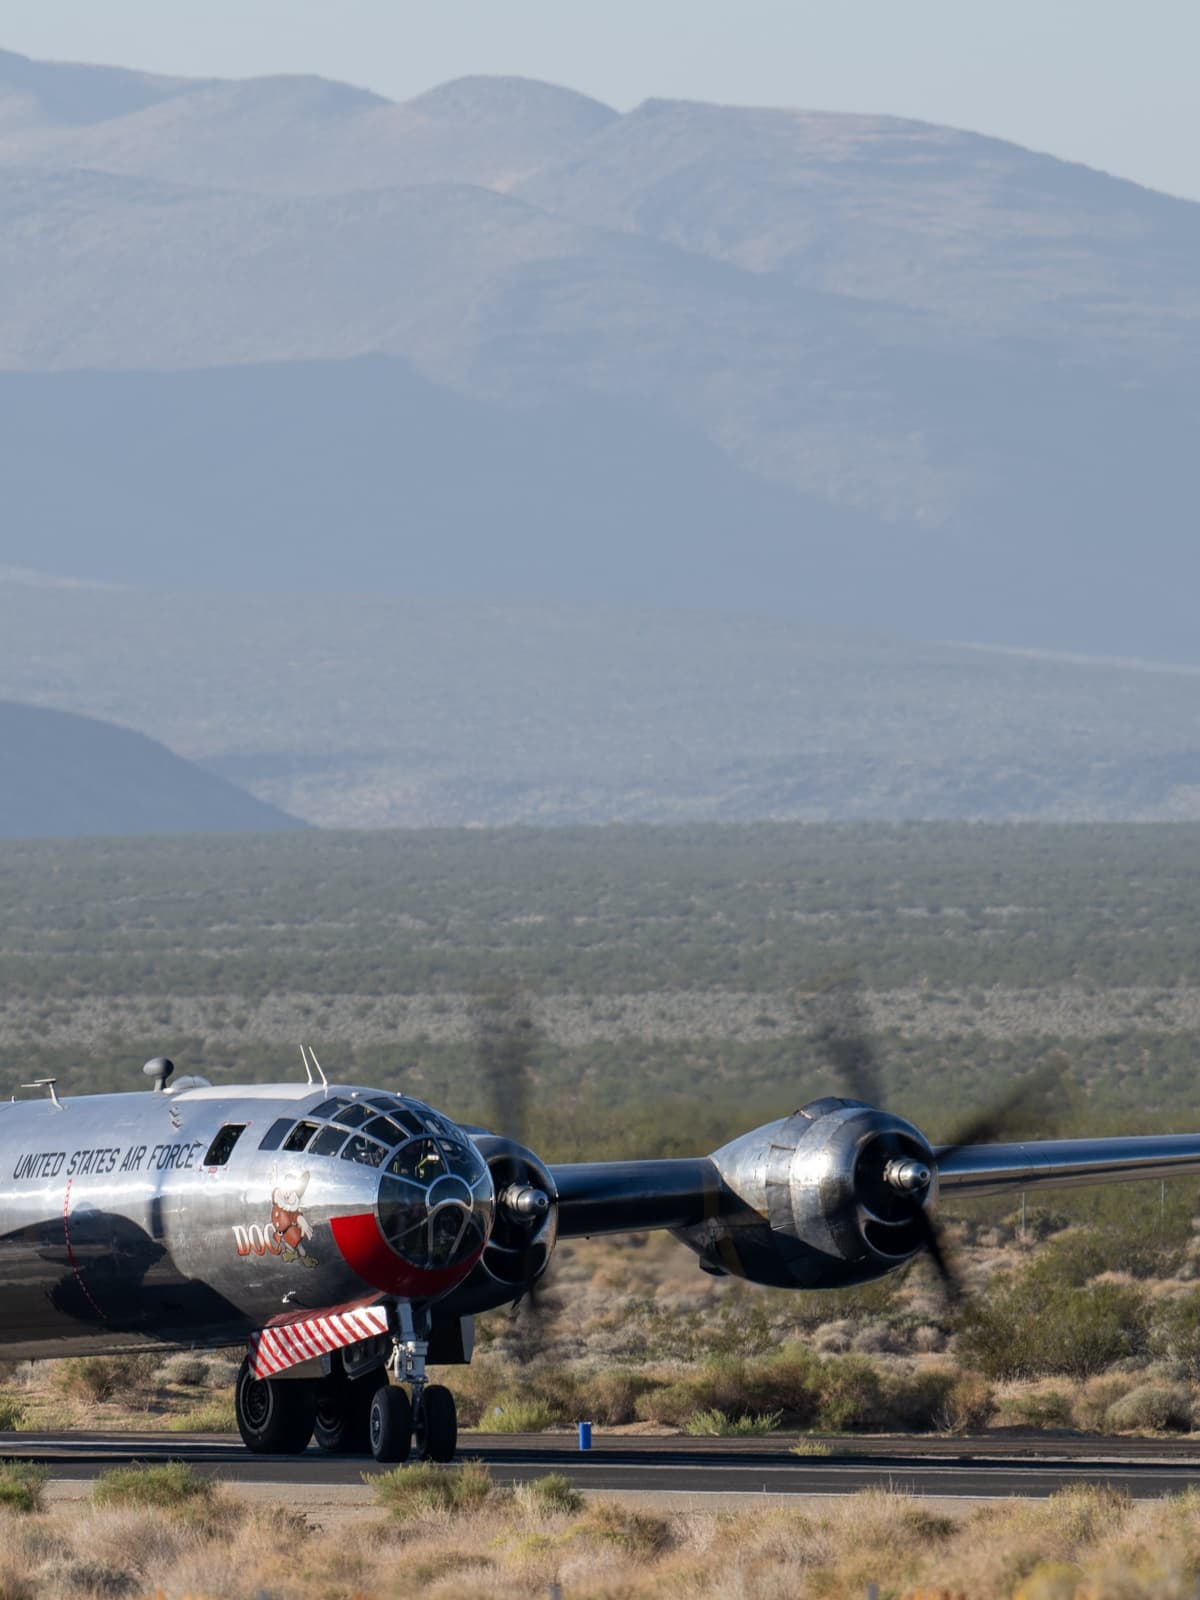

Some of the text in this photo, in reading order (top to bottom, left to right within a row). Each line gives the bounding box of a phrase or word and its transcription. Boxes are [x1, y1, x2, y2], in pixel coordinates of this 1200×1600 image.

[13, 1143, 201, 1180] UNITED STATES AIR FORCE
[232, 1223, 282, 1256] DOC
